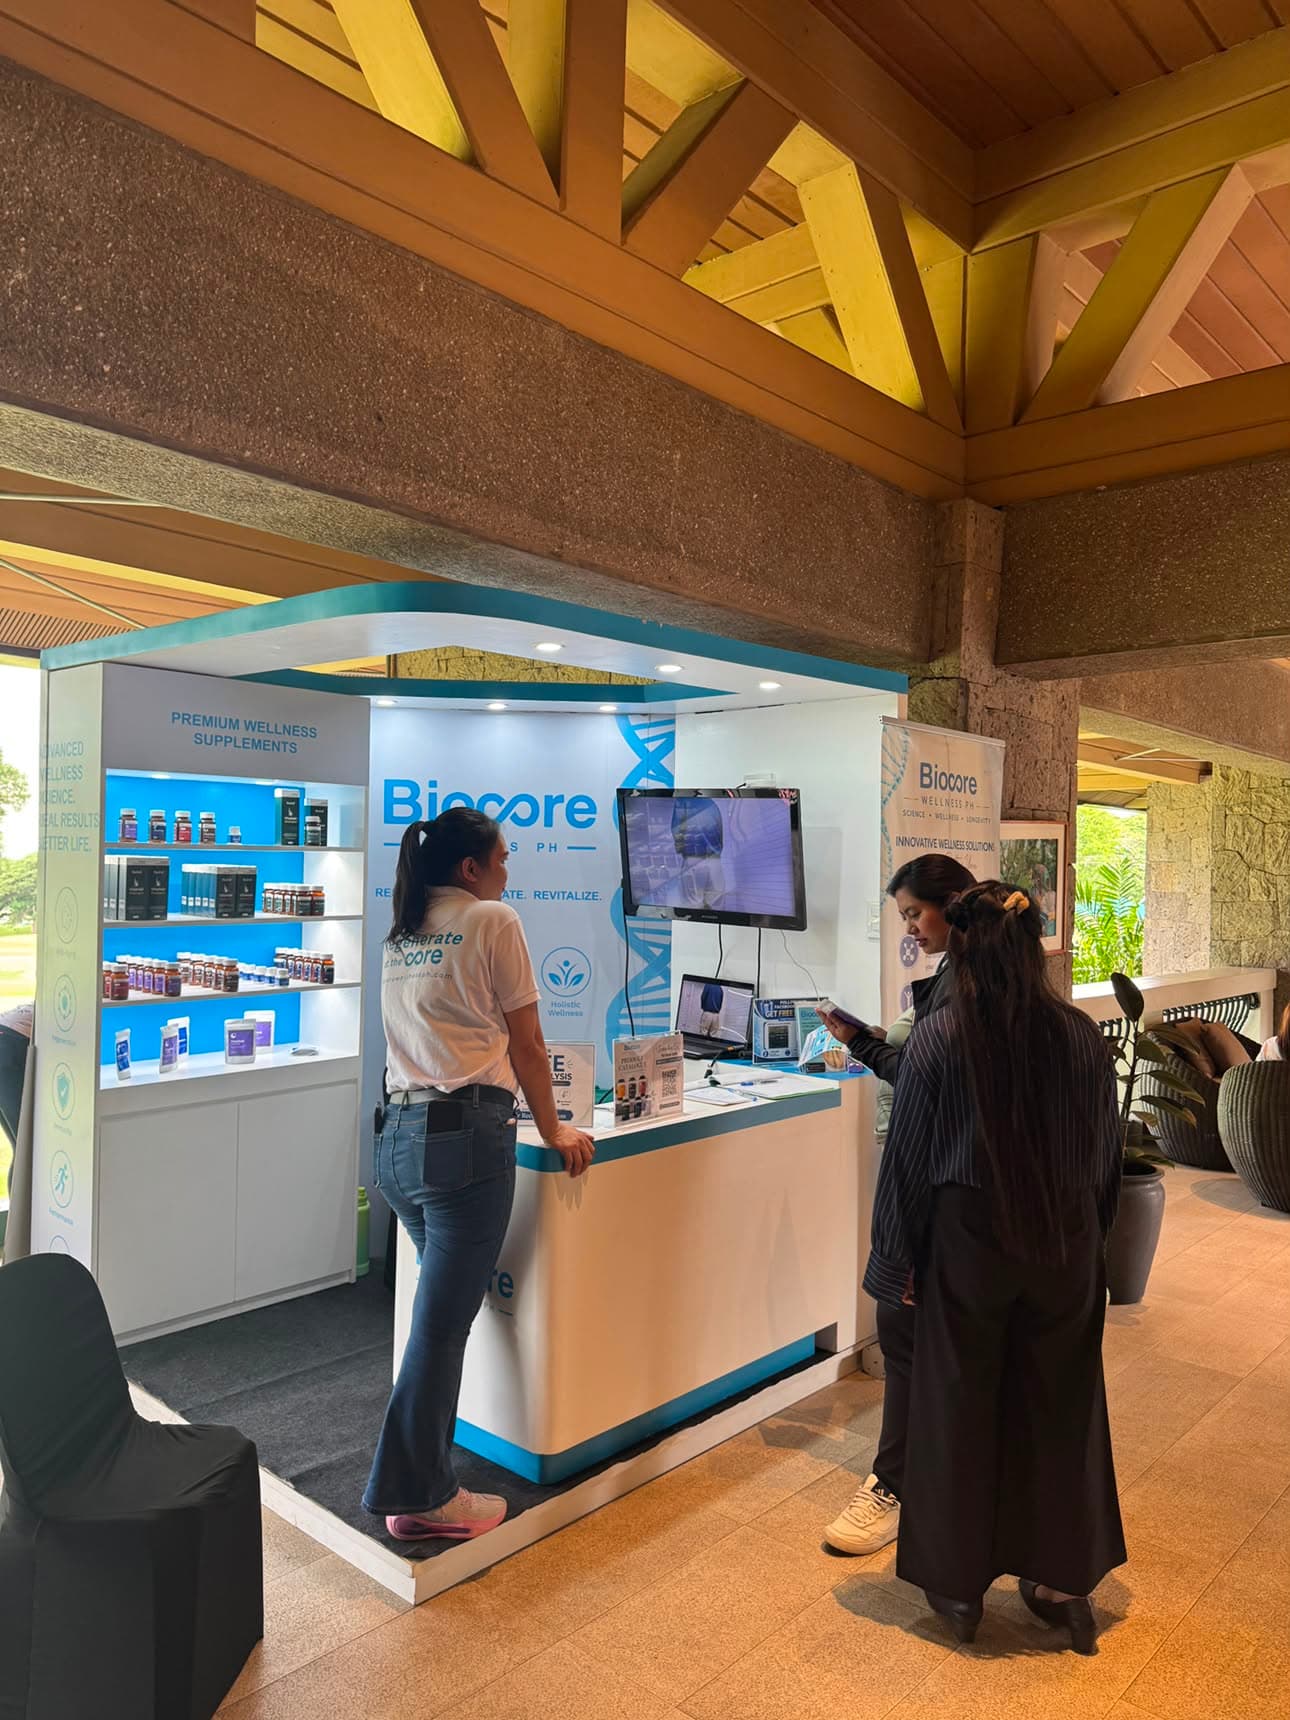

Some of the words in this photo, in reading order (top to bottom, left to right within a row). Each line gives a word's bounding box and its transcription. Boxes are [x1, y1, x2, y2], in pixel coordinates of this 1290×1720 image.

[171, 711, 240, 731] PREMIUM
[244, 719, 318, 738] WELLNESS
[193, 732, 298, 754] SUPPLEMENTS
[920, 761, 977, 795] Biocore
[921, 796, 962, 808] WELLNESS
[965, 801, 974, 809] PH
[61, 812, 100, 829] RESULTS
[902, 809, 926, 818] SCIENCE
[71, 836, 92, 852] LIFE.
[537, 842, 559, 853] PH
[895, 836, 937, 849] INNOVATIVE
[938, 839, 965, 850] WELLNESS
[534, 889, 604, 902] REVITALIZE.
[404, 948, 443, 967] core
[548, 1009, 583, 1017] Wellness
